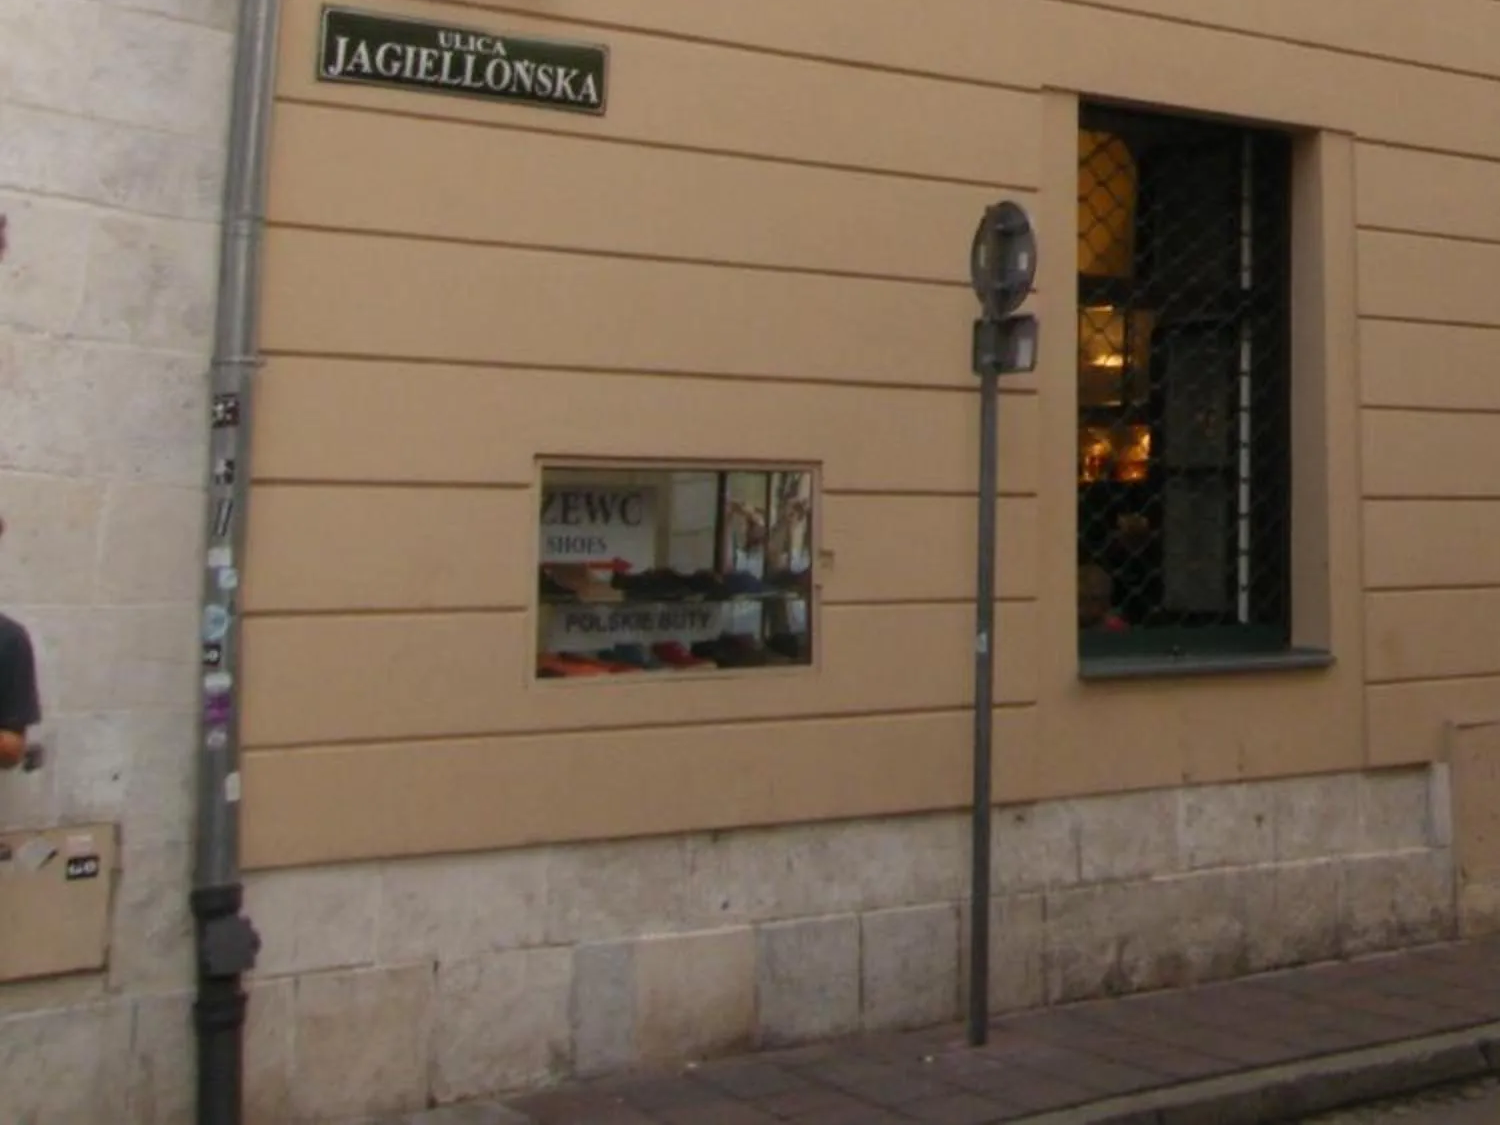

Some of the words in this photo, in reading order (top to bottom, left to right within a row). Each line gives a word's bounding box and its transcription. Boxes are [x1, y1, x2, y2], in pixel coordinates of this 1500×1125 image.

[437, 31, 506, 55] ULICA
[329, 36, 599, 104] JAGIELLOŃSKA
[547, 535, 607, 555] SHOES
[657, 611, 712, 630] BUTY
